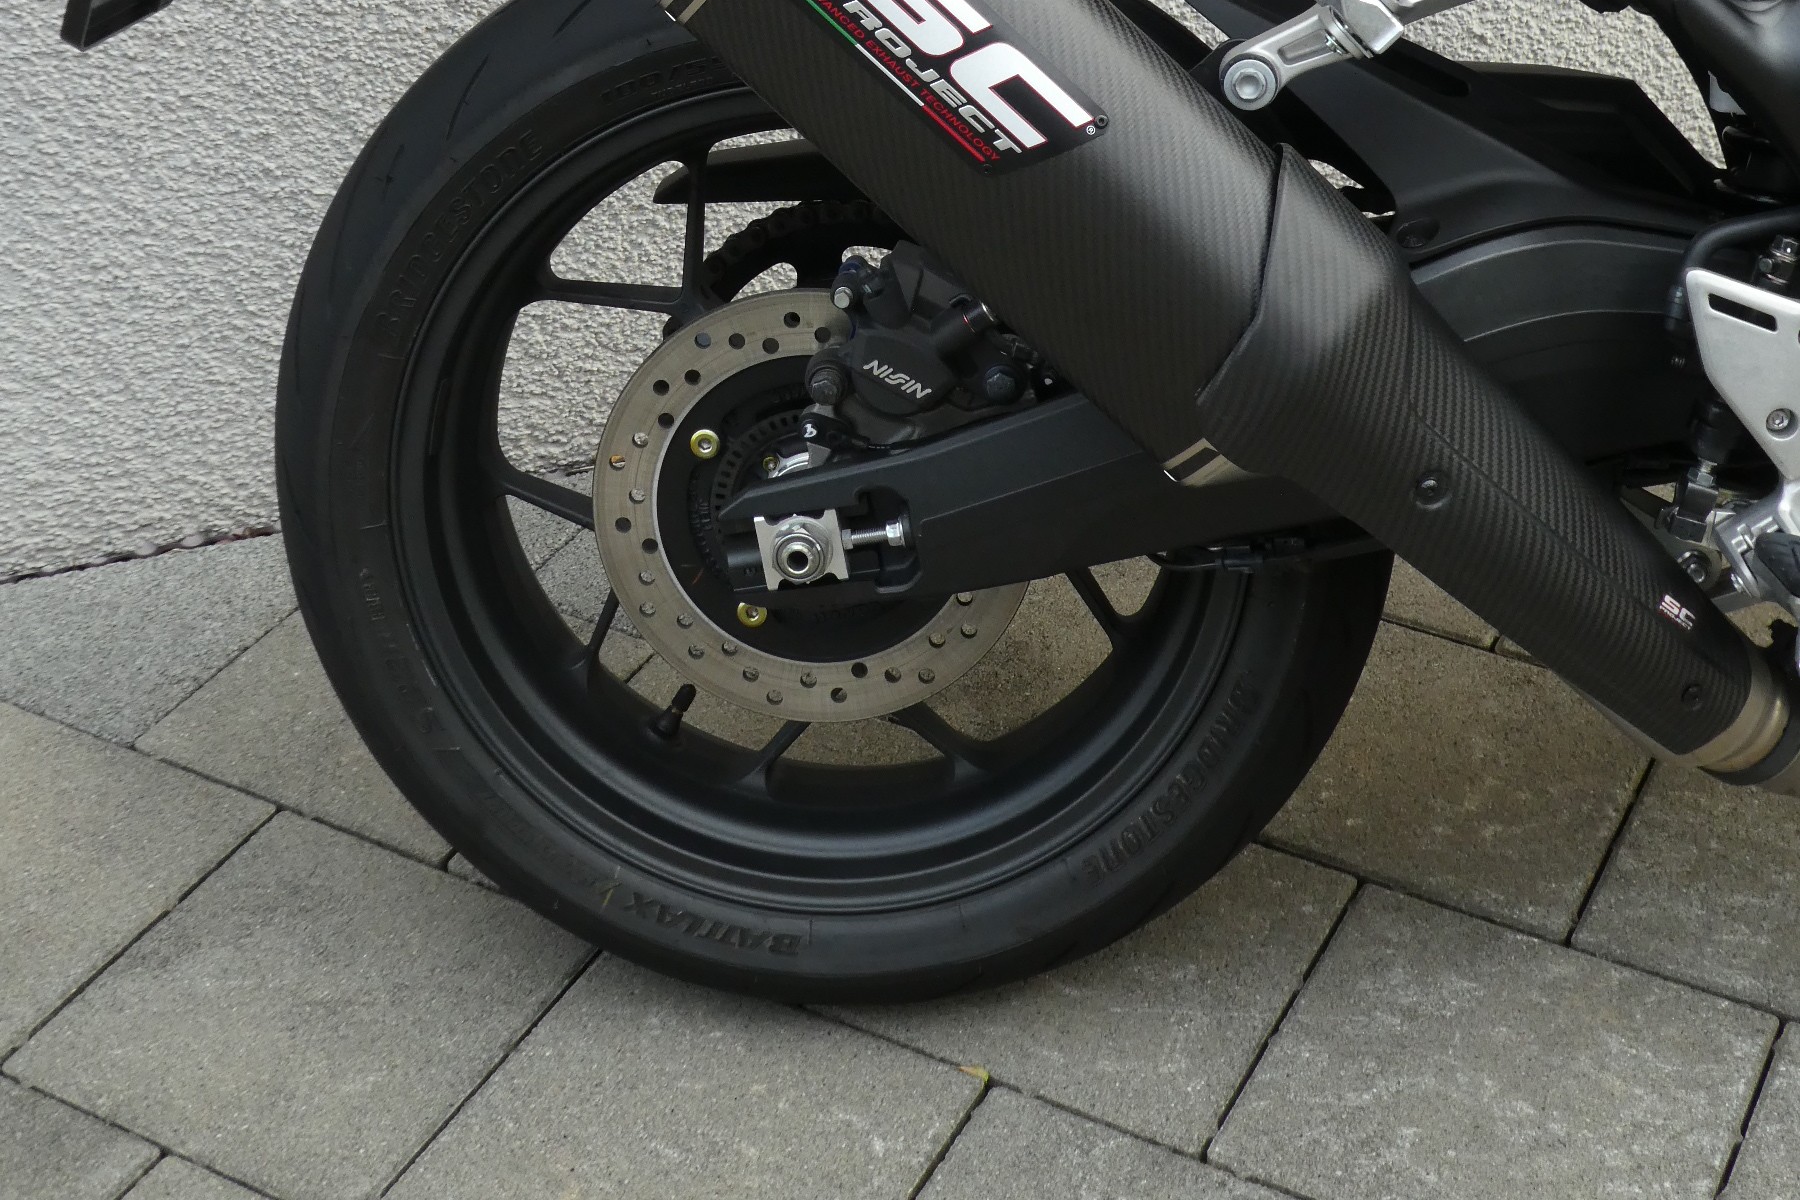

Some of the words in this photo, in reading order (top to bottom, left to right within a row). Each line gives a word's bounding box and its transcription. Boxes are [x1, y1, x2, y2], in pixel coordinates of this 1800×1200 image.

[864, 38, 919, 87] EXHAUST
[918, 86, 1001, 161] TECHNOLOGY
[861, 358, 933, 399] NISIN
[1661, 593, 1696, 627] SC
[1080, 673, 1260, 887] BRIDGESTONE
